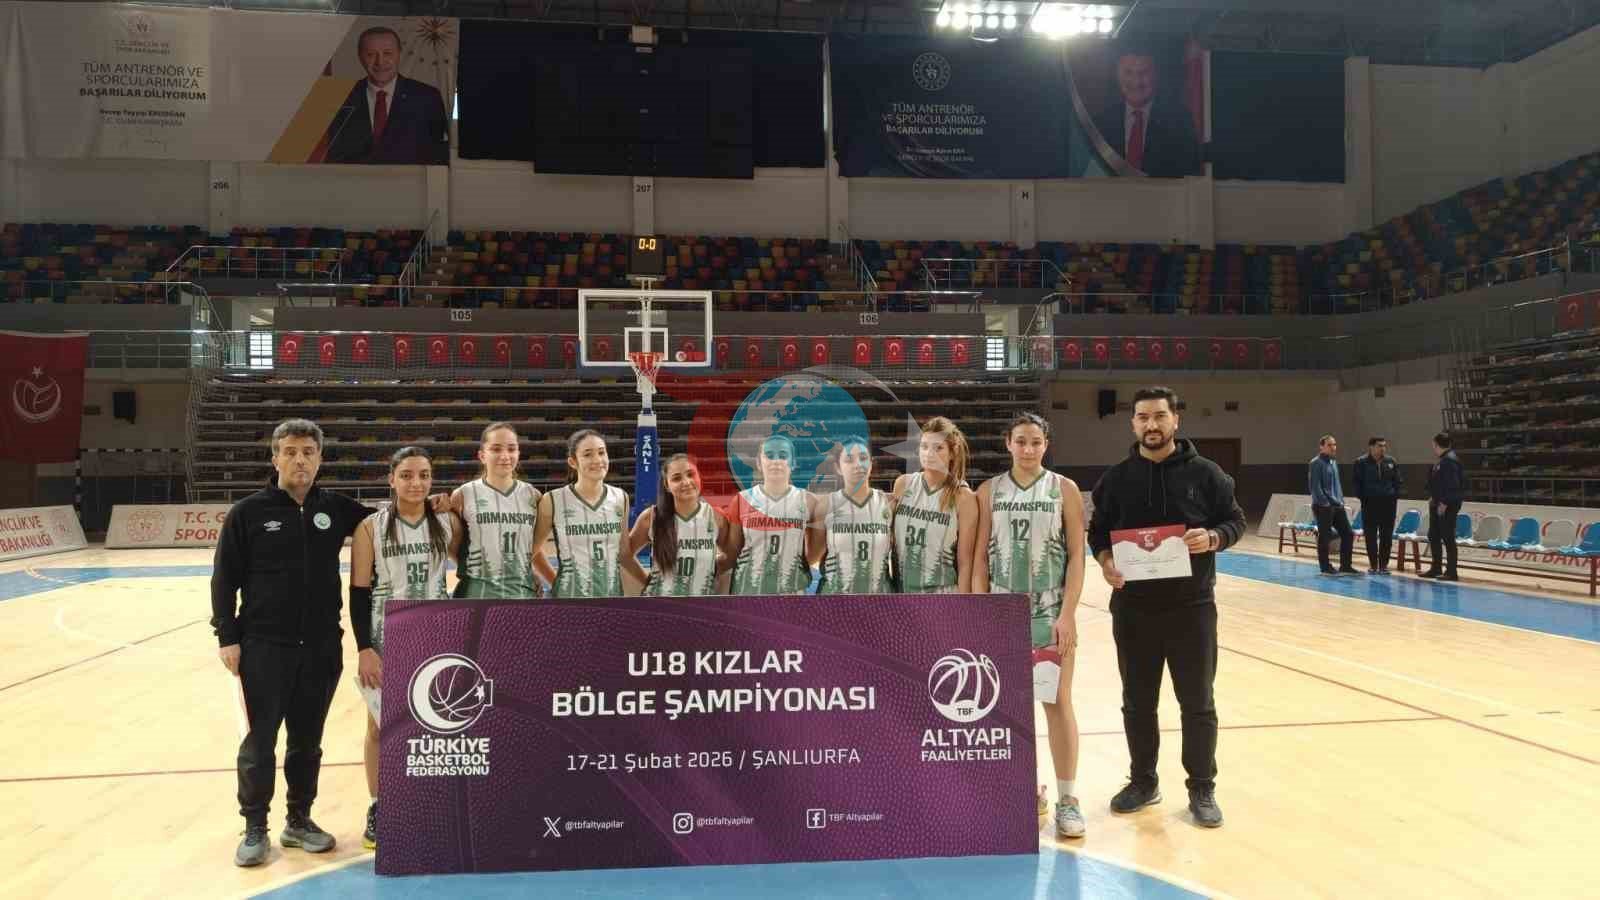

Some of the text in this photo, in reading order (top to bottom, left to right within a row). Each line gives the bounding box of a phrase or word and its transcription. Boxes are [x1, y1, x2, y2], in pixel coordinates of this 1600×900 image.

[114, 63, 185, 77] ANTRENÖR
[186, 66, 205, 78] VE
[86, 74, 200, 89] SPORCULARIMIZA
[80, 88, 141, 99] BAŞARILAR
[918, 103, 975, 115] ANTRENÖR
[895, 113, 986, 126] SPORCULARIMIZA
[636, 184, 651, 193] 207
[453, 310, 471, 320] 105
[183, 511, 227, 524] T.C. G
[174, 528, 218, 541] SPOR
[905, 525, 928, 549] 34
[1010, 518, 1030, 541] 12
[503, 531, 517, 553] 11
[770, 534, 781, 555] 9
[592, 540, 604, 561] 5
[858, 541, 869, 561] 8
[407, 562, 429, 585] 35
[678, 556, 695, 577] 10
[628, 650, 803, 677] U18 KIZLAR
[552, 682, 875, 720] BÖLGE ŞAMPİYONASI
[956, 706, 974, 716] TBF
[407, 734, 490, 754] TÜRKİYE
[921, 728, 1011, 747] ALTYAPI
[407, 754, 490, 766] BASKETBOL
[567, 748, 861, 773] 17-21 Şubat 2026 / ŞANLIURFA
[921, 747, 1011, 761] FAALİYETLERİ
[406, 765, 490, 777] FEDERASYONU
[828, 813, 845, 822] TBF
